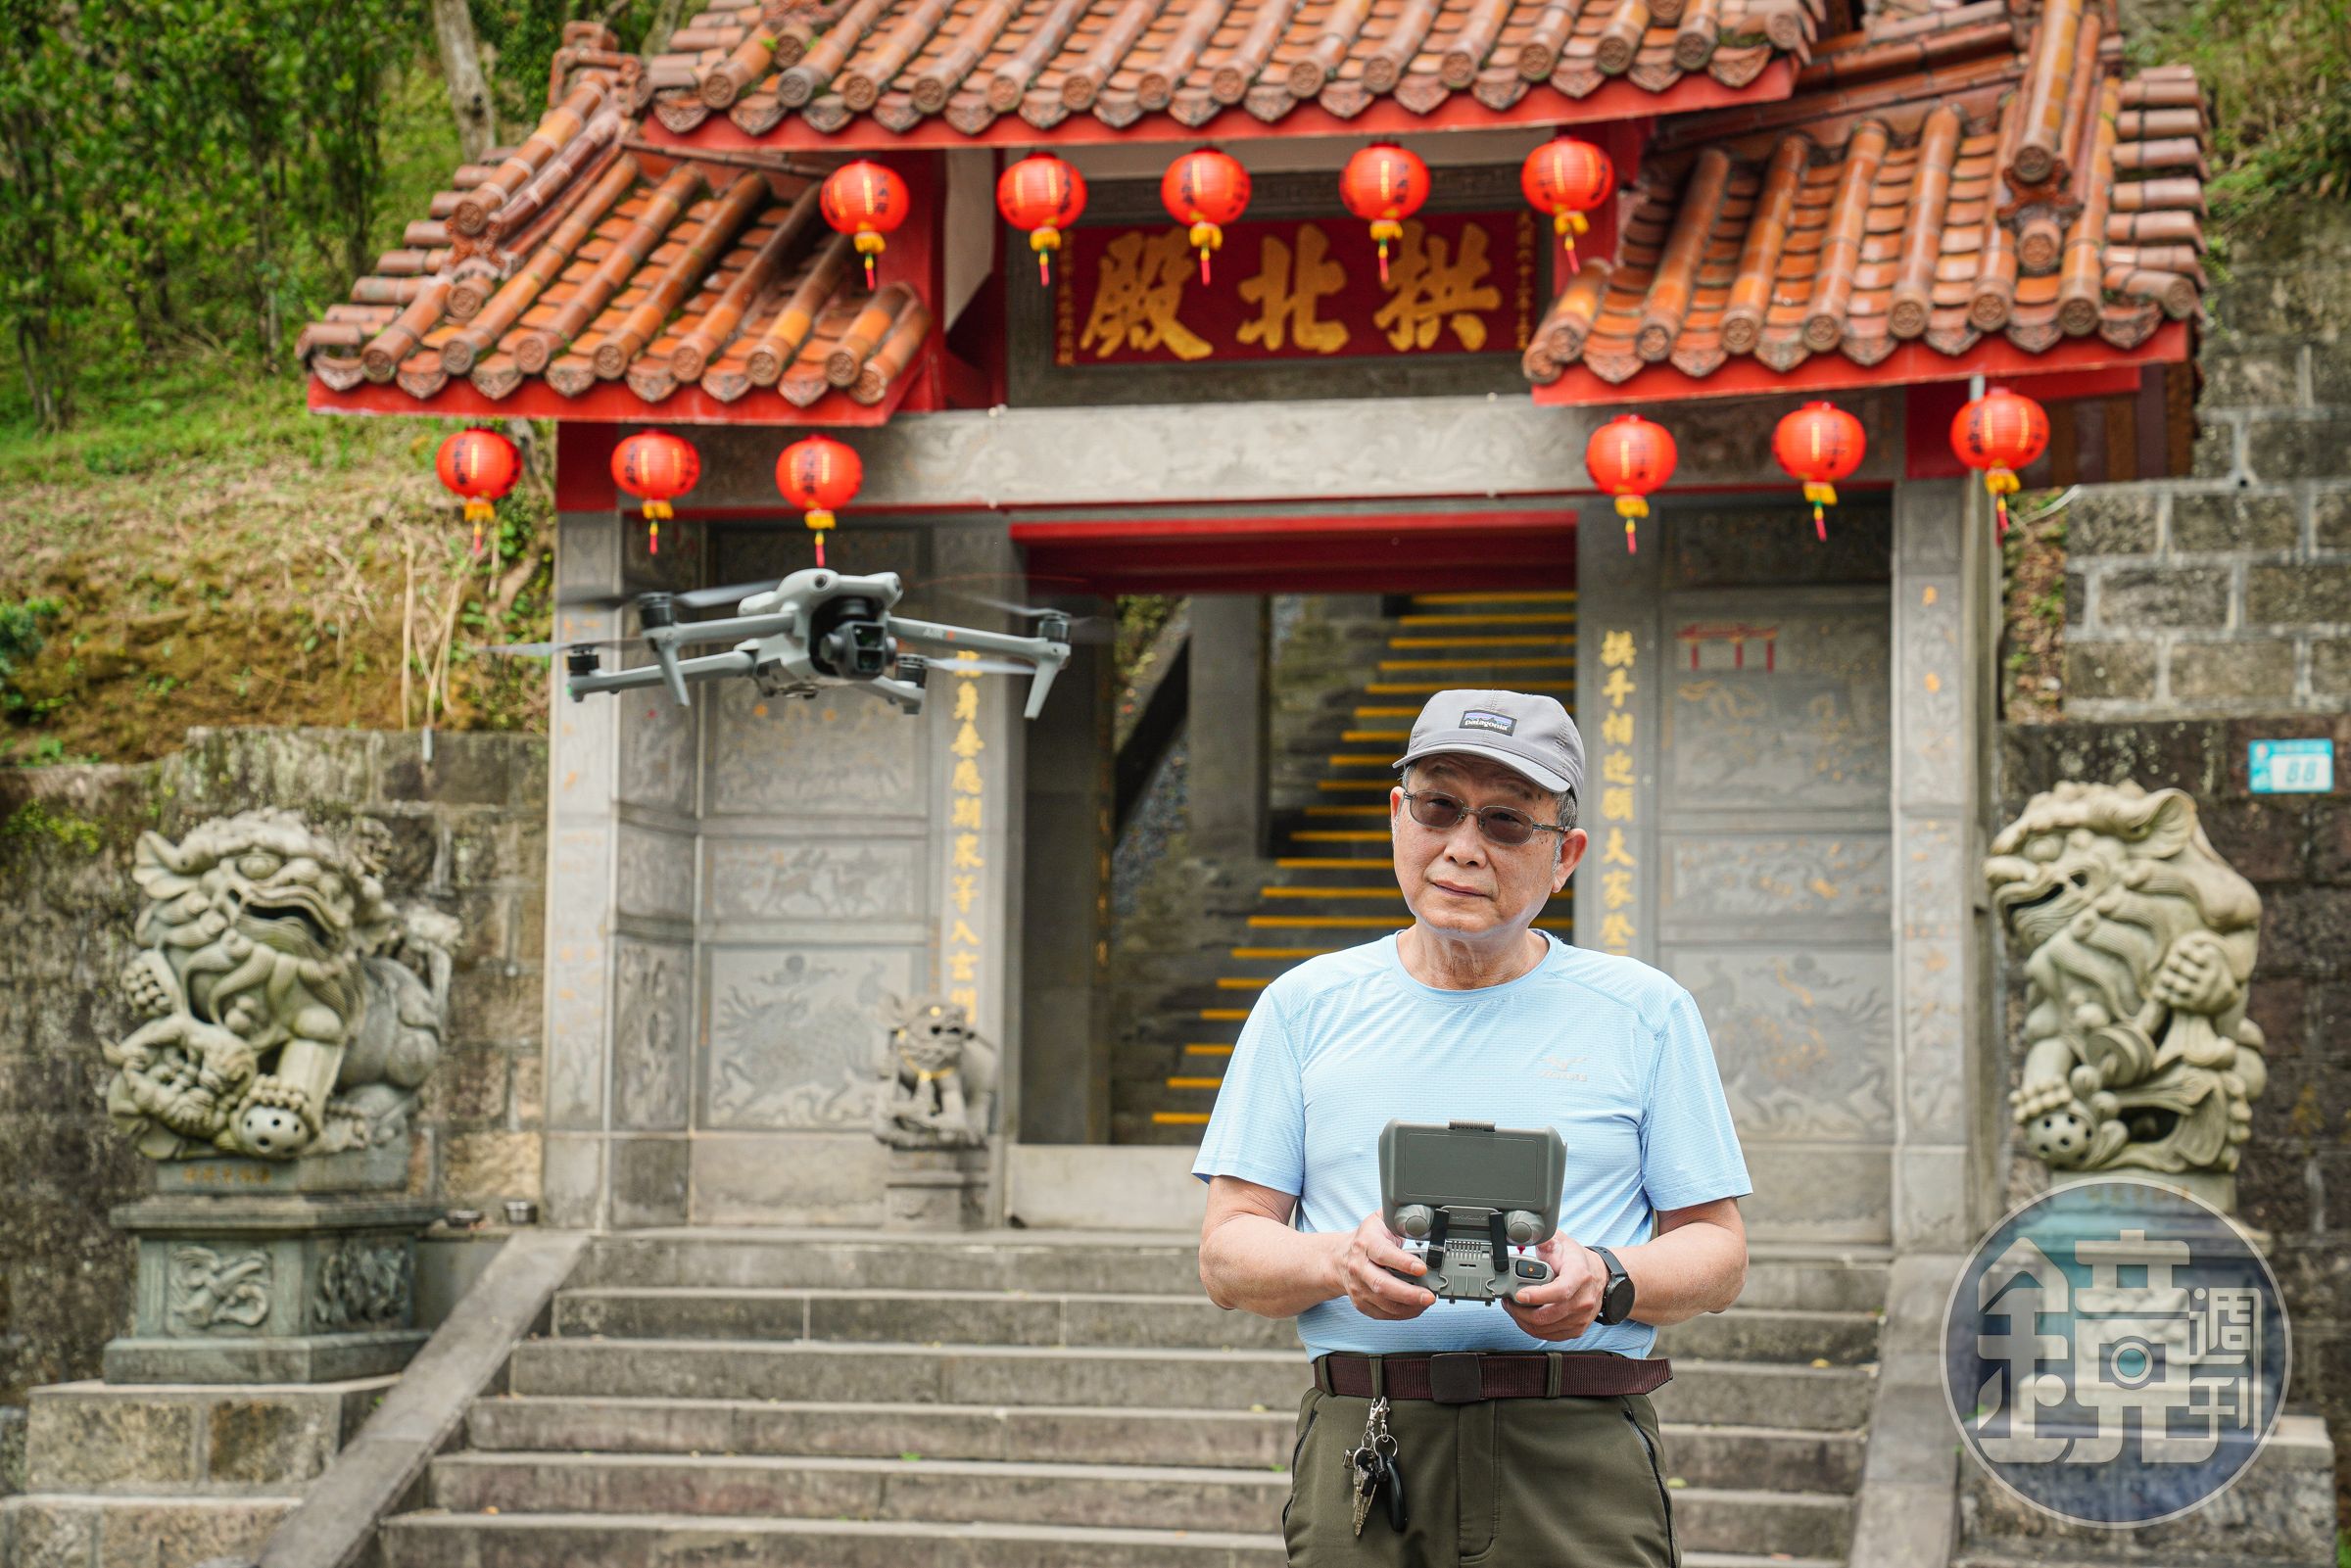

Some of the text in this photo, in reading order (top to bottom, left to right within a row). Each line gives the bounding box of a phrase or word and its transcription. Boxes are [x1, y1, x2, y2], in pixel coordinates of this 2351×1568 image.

[1080, 219, 1503, 361] 拱北殿
[1463, 719, 1509, 732] patagonia
